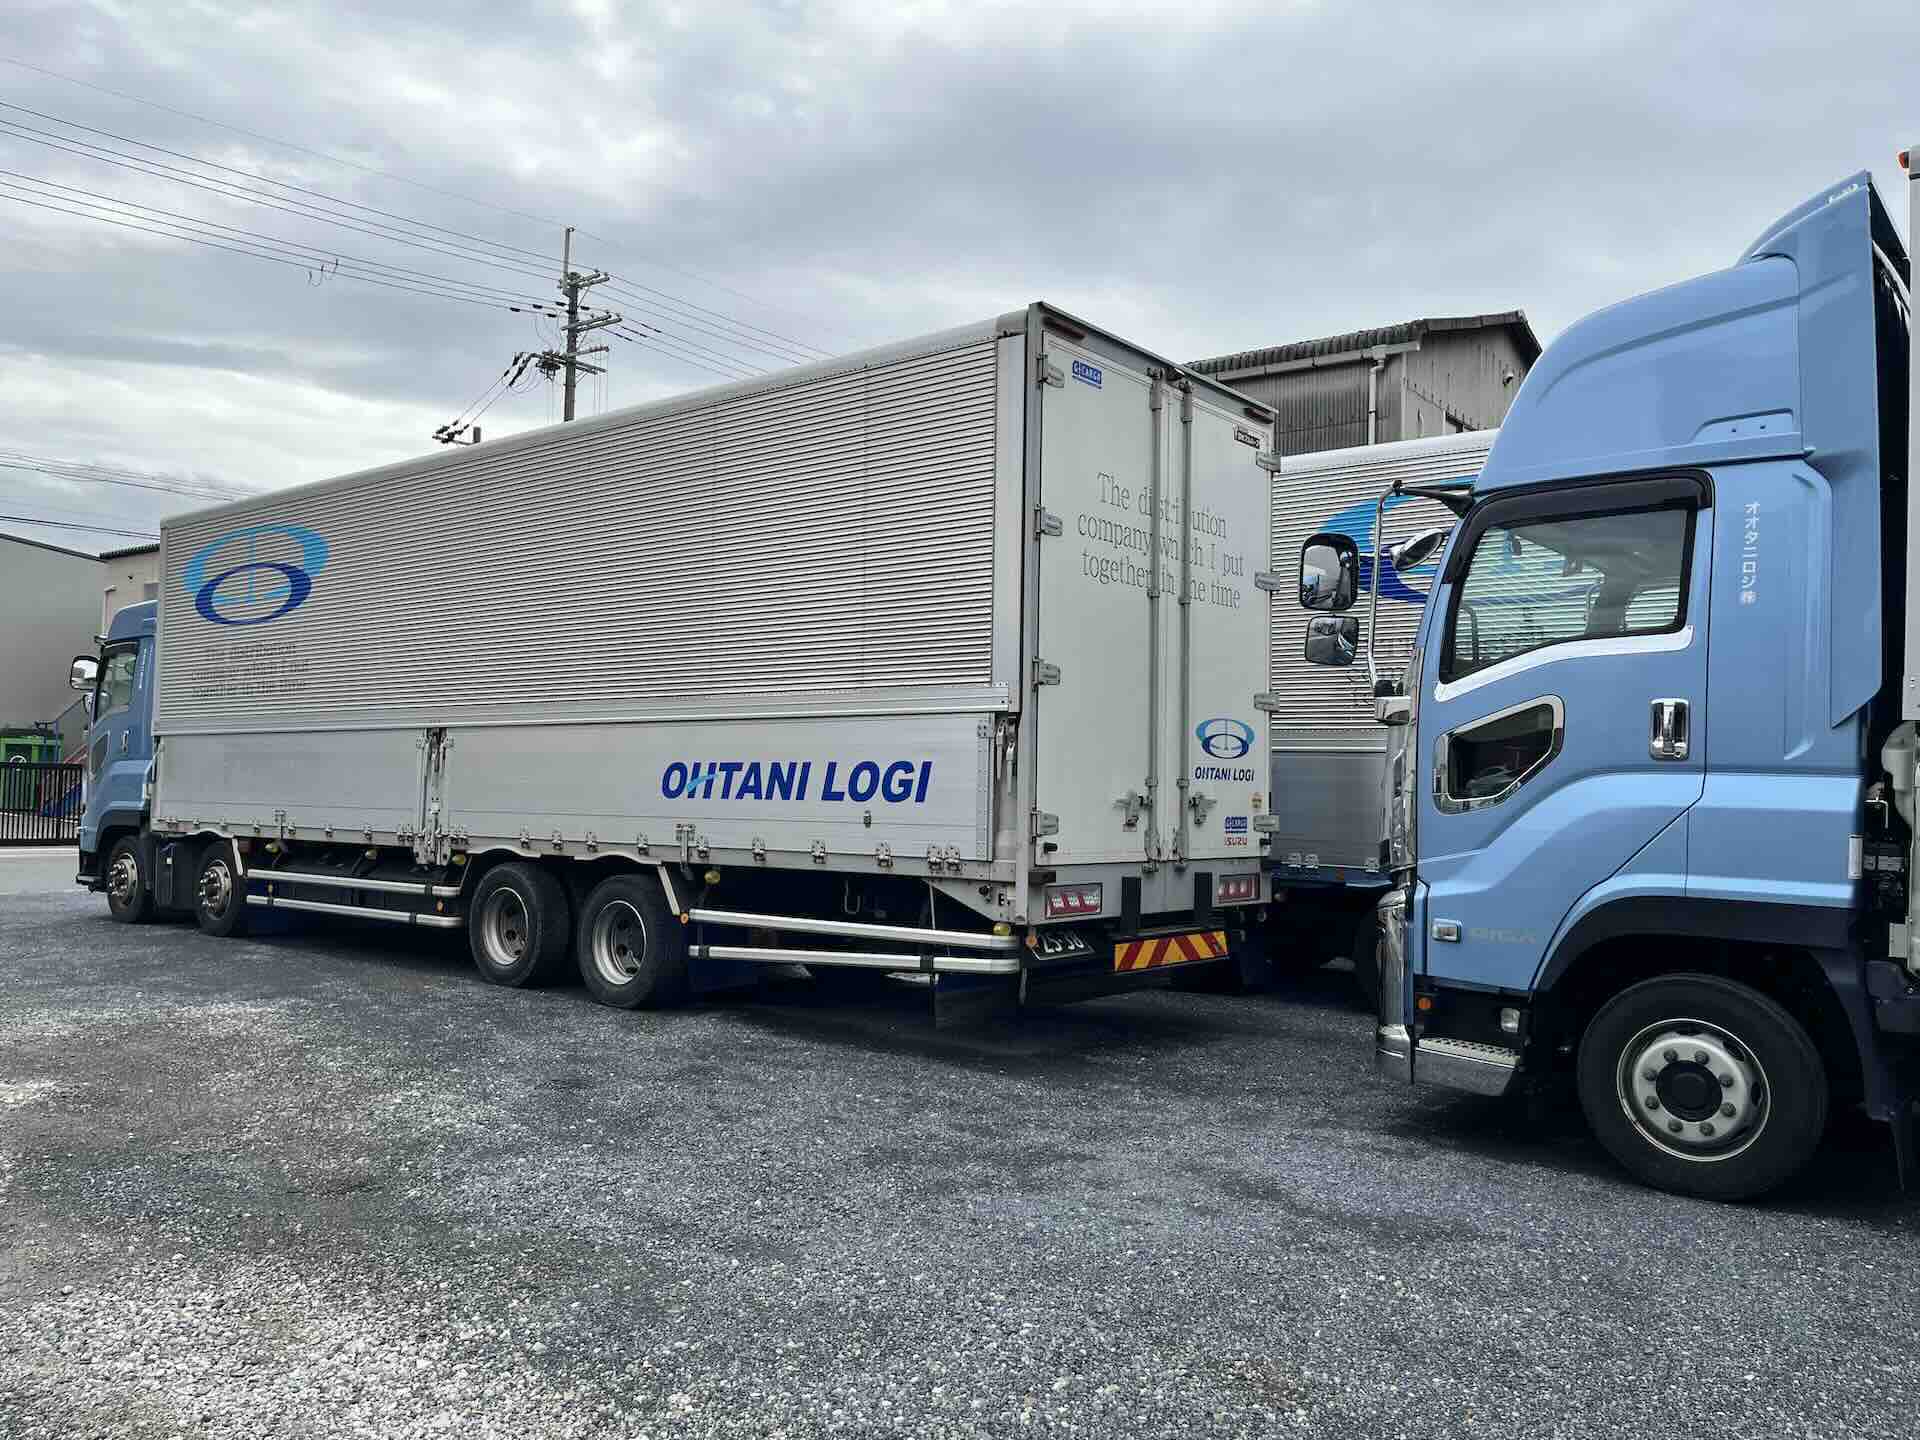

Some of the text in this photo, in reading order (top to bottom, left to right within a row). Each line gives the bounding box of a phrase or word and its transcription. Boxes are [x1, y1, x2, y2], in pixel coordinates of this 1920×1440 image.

[1097, 471, 1227, 539] The distriution
[1078, 513, 1152, 556] company
[1157, 535, 1203, 566] whh
[1223, 551, 1245, 577] put
[1080, 548, 1152, 585] together
[1161, 564, 1176, 595] in
[1211, 577, 1241, 609] time
[661, 760, 933, 803] OHTANI LOGI
[1195, 766, 1255, 782] OHTANI LOGI
